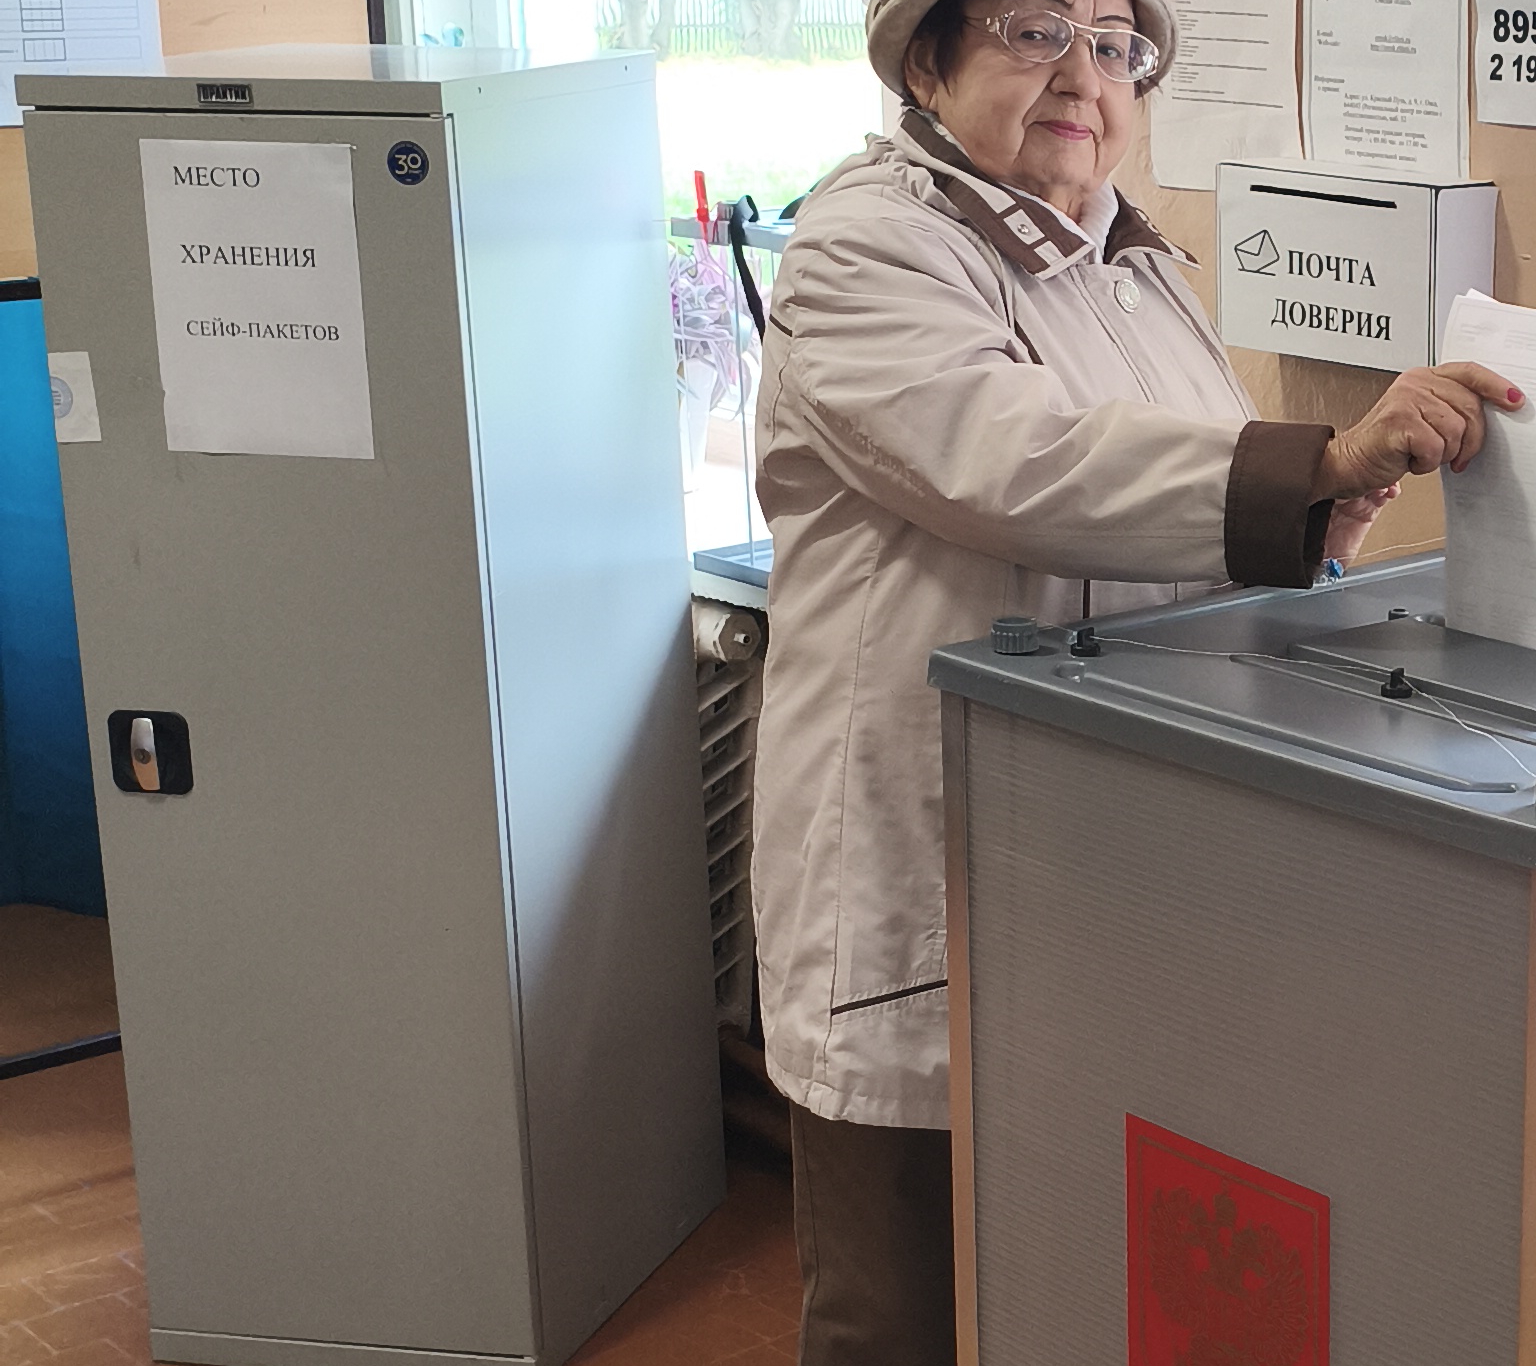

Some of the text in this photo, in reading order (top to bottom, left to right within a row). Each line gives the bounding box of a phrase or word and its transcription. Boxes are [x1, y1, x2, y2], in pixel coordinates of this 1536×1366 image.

[1489, 54, 1503, 81] 2
[394, 153, 422, 175] 30
[172, 166, 260, 188] МЕСТО
[180, 244, 317, 268] ХРАНЕНИЯ
[1287, 249, 1376, 287] ПОЧТА
[186, 318, 340, 341] СЕЙФ-ПАКЕТОВ
[1270, 298, 1392, 341] ДОВЕРИЯ
